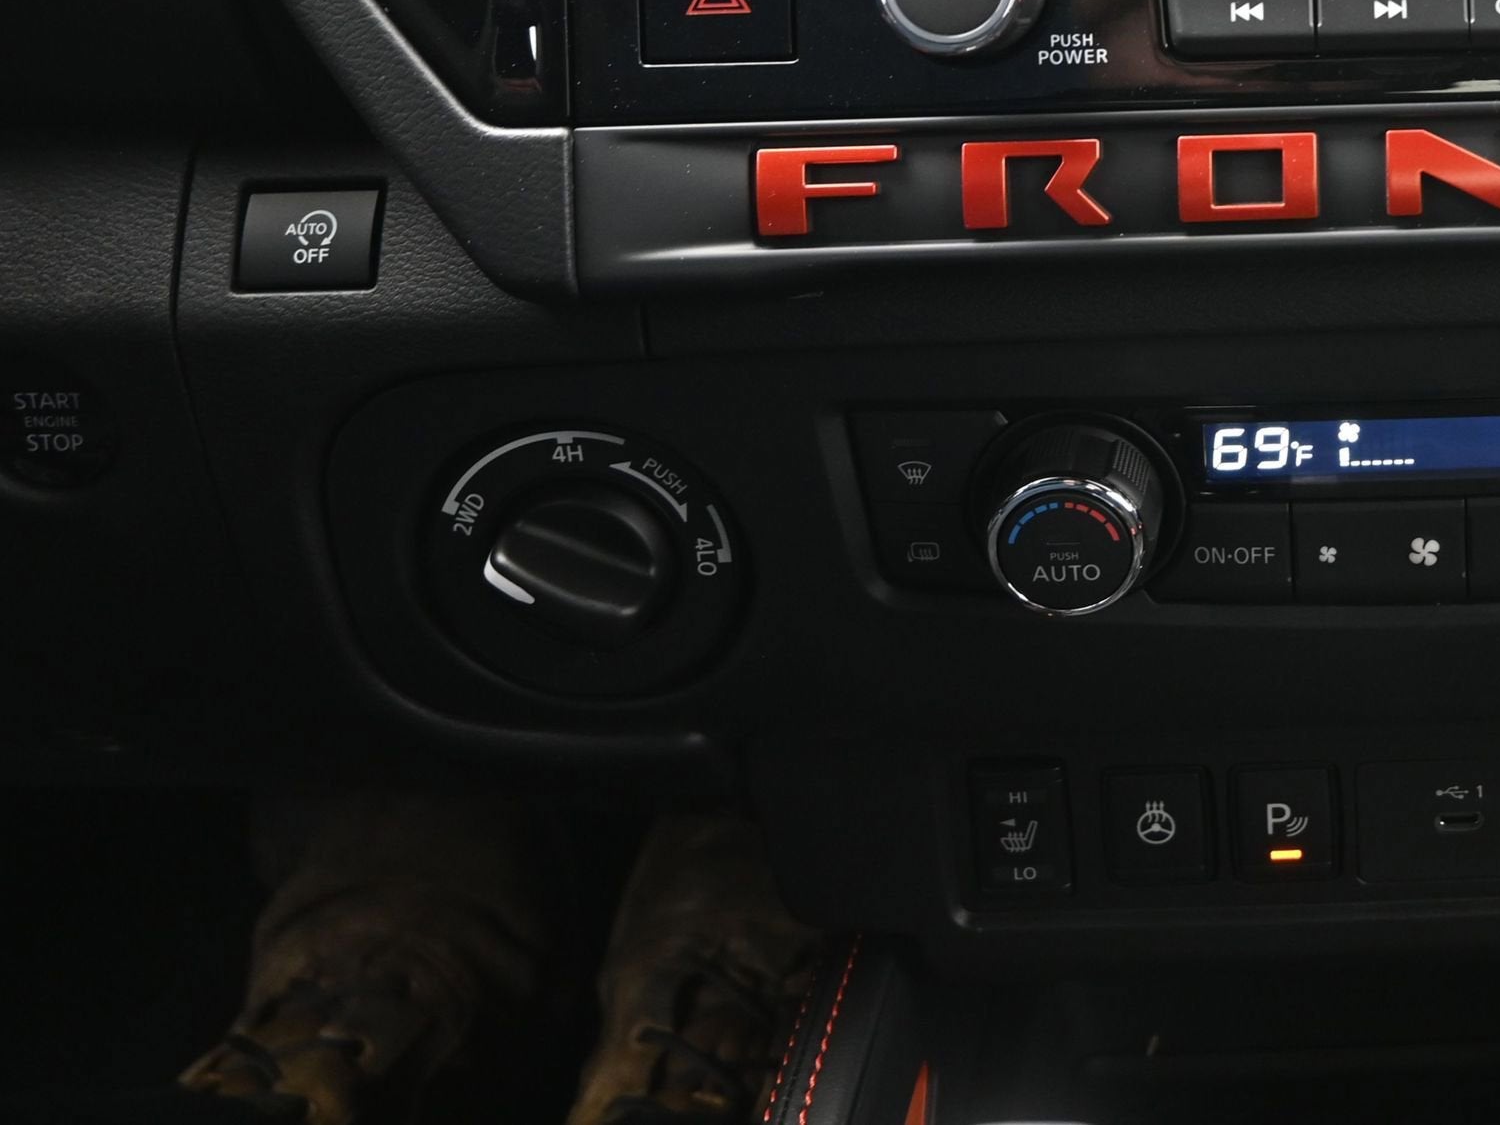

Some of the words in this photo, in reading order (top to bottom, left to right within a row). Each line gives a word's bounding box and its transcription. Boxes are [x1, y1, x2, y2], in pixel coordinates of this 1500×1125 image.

[1049, 33, 1094, 48] PUSH
[1038, 44, 1109, 65] POWER
[284, 220, 328, 238] AUTO
[293, 247, 330, 264] OFF
[13, 392, 81, 410] START
[23, 415, 78, 428] ENGINE
[26, 433, 84, 452] STOP
[551, 441, 584, 463] 4H
[642, 458, 688, 496] PUSH
[453, 492, 485, 536] 2WD
[695, 537, 719, 576] 4LO
[1049, 551, 1079, 561] PUSH
[1032, 563, 1101, 583] AUTO
[1008, 791, 1028, 804] HI
[1476, 784, 1483, 799] 1
[1013, 866, 1037, 881] LO
